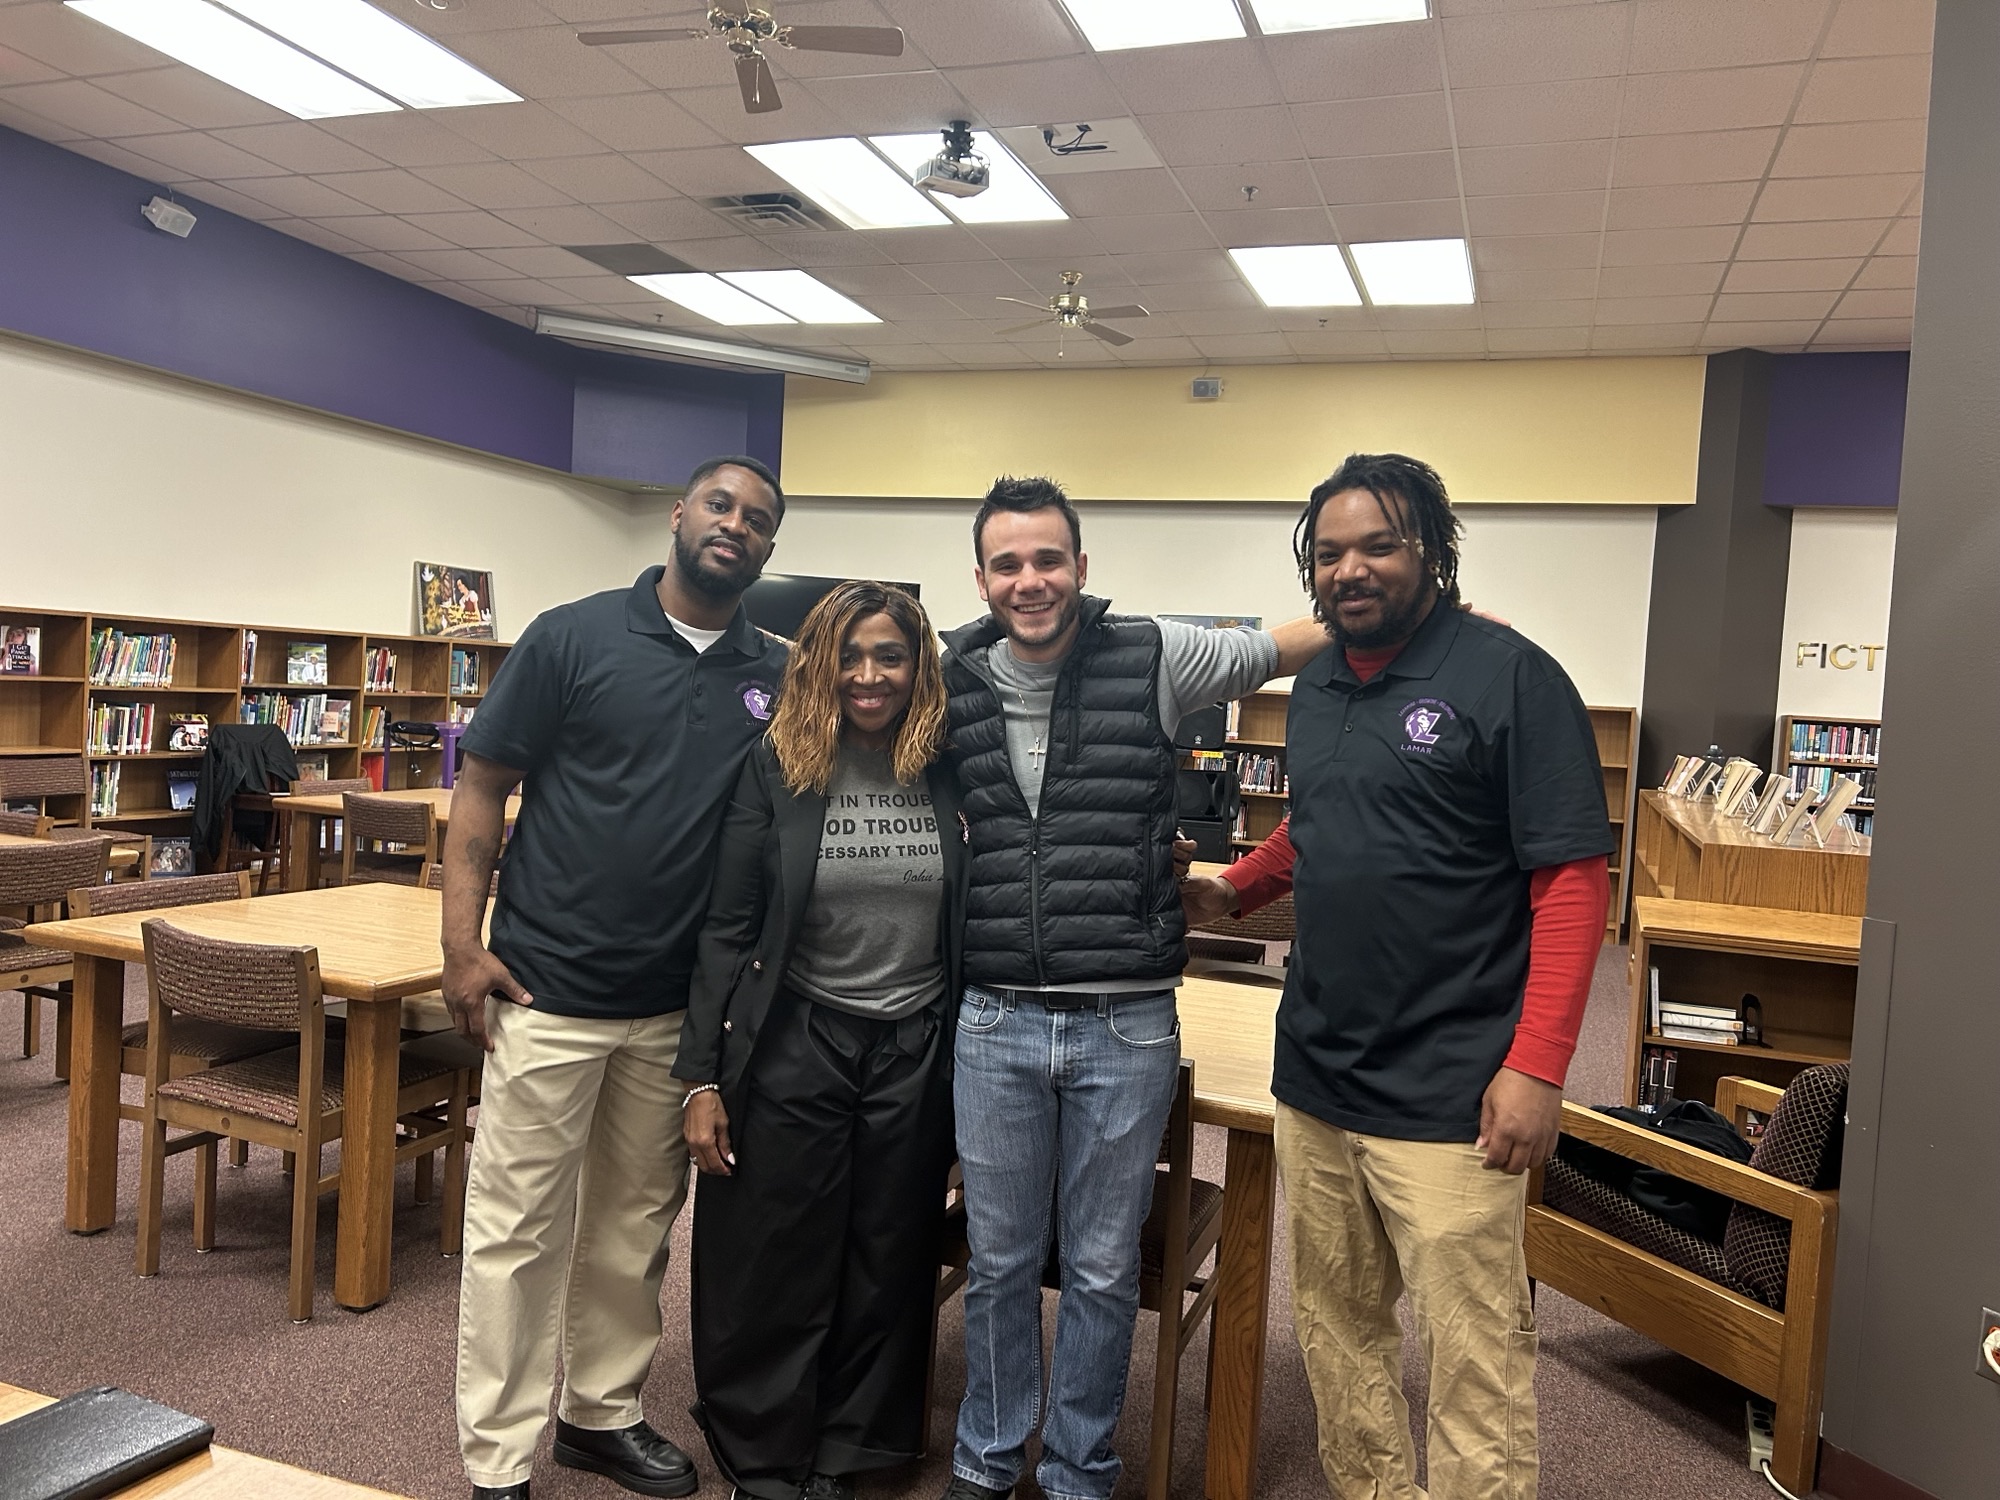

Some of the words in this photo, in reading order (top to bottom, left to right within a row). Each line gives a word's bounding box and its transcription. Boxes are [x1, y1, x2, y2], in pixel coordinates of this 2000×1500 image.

[1797, 642, 1885, 671] FICT
[1400, 743, 1432, 755] LAMAR
[840, 794, 858, 808] IN
[866, 794, 932, 808] TROUB
[826, 818, 856, 836] OD
[864, 817, 937, 835] TROUB
[896, 843, 943, 857] TROU
[903, 869, 934, 884] John
